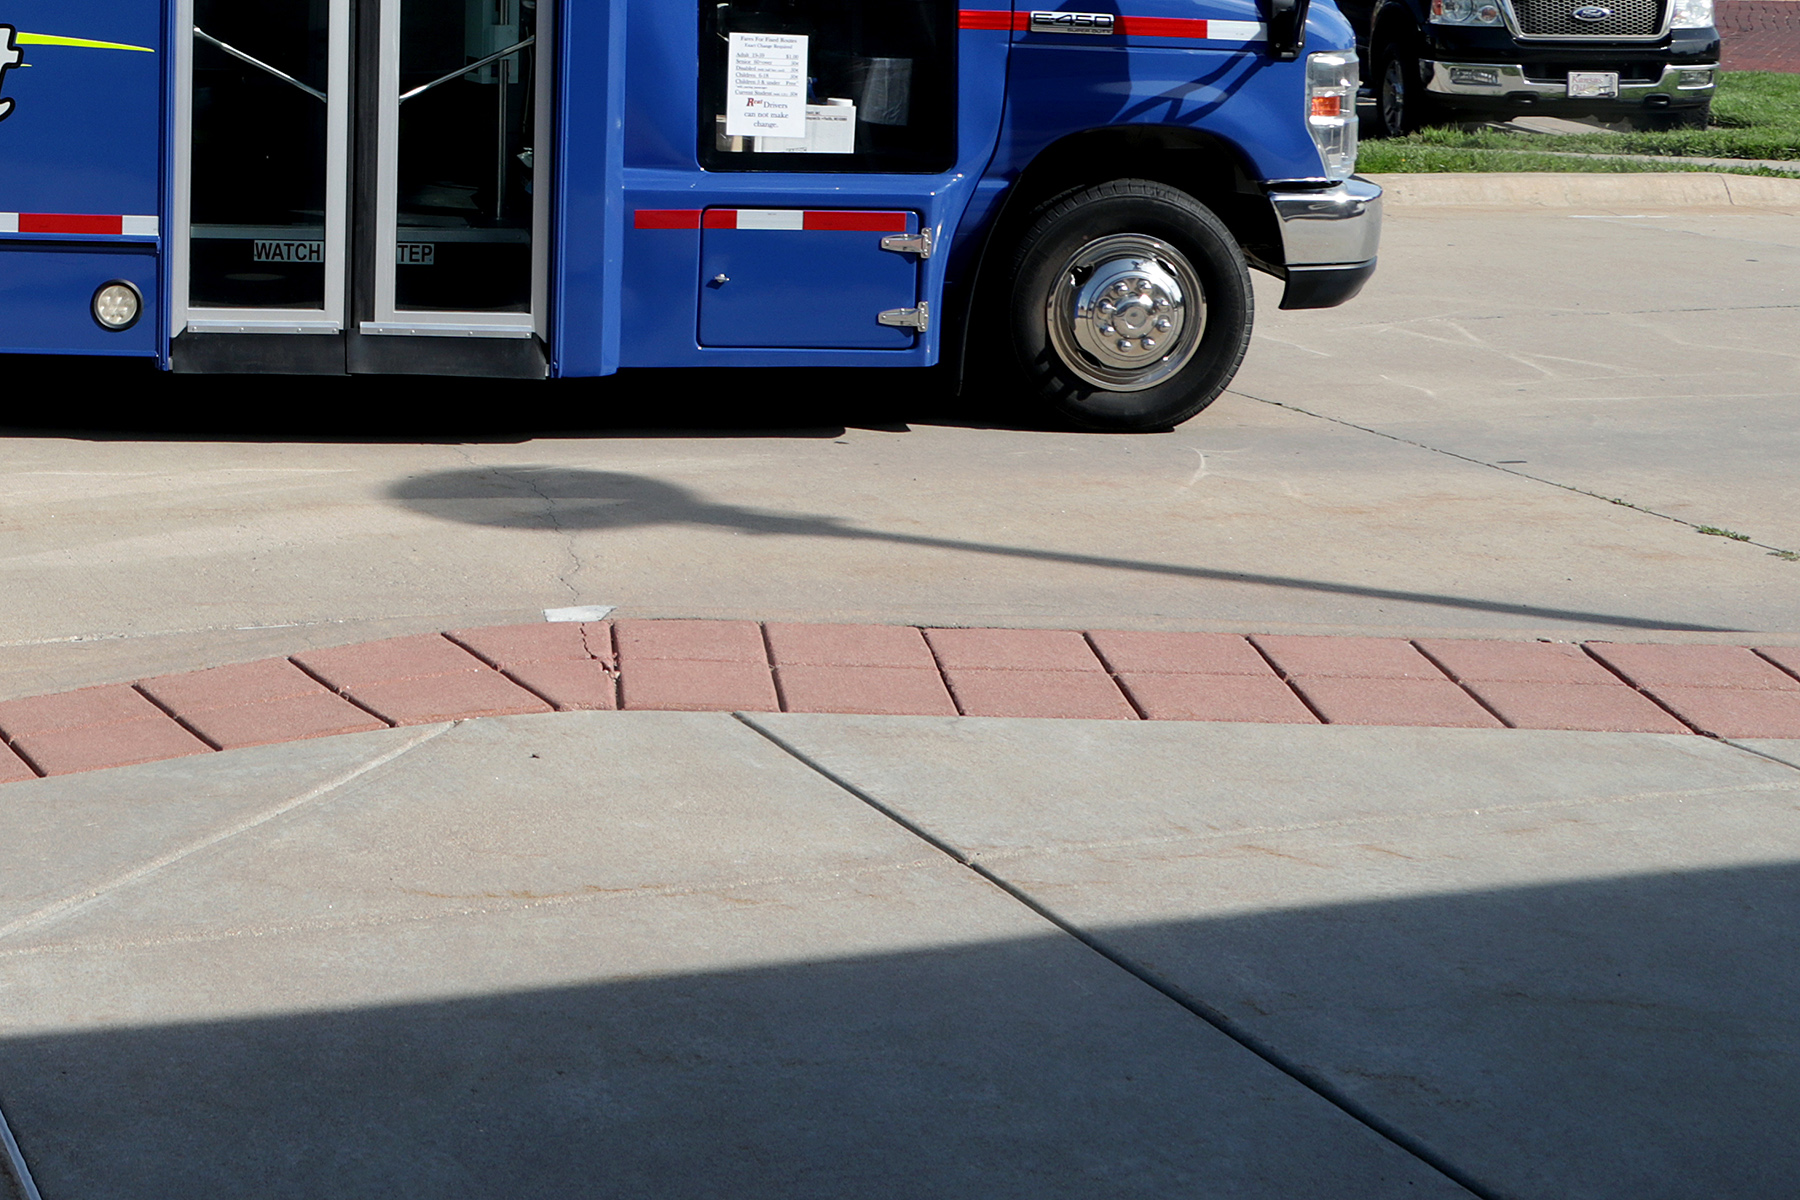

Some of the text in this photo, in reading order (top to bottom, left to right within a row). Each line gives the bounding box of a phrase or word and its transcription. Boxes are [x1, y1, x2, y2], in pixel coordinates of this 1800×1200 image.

[1033, 13, 1112, 28] E-450
[746, 98, 762, 107] Rcat
[255, 243, 432, 262] WATCH TEP
